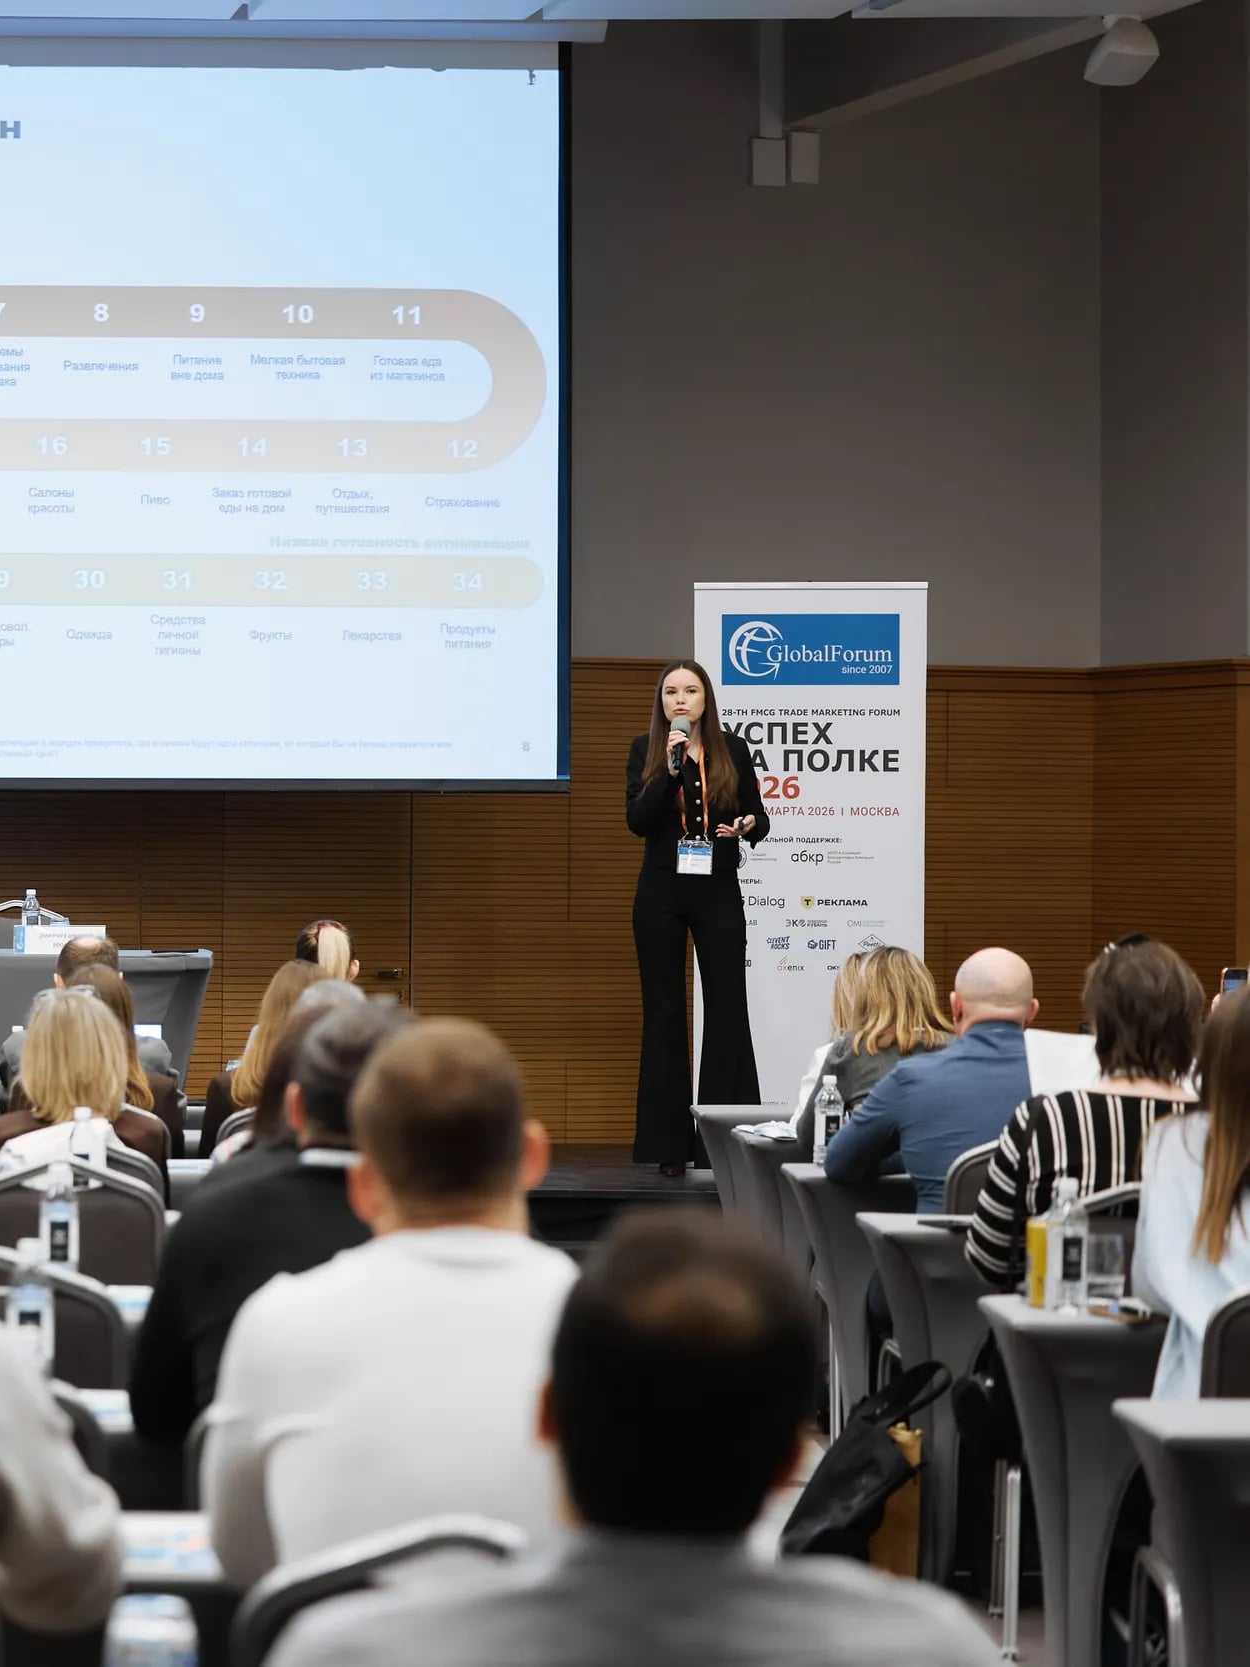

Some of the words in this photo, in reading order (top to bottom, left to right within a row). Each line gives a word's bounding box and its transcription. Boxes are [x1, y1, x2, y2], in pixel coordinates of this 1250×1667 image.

[94, 303, 108, 323] 8
[190, 303, 205, 323] 9
[282, 305, 314, 324] 10
[392, 306, 422, 324] 11
[63, 360, 138, 372] Развлечения
[172, 355, 222, 366] Питание
[250, 355, 292, 366] Мелкая
[296, 355, 346, 366] бытовая
[374, 356, 418, 367] Готовая
[419, 356, 442, 368] еда
[196, 370, 224, 382] дома
[276, 370, 320, 380] техника
[386, 371, 445, 382] магазинов
[38, 435, 68, 456] 16
[140, 436, 172, 456] 15
[236, 437, 268, 457] 14
[336, 438, 368, 458] 13
[448, 439, 478, 459] 12
[74, 570, 105, 589] 30
[163, 570, 192, 590] 31
[254, 570, 286, 590] 32
[358, 572, 388, 590] 33
[452, 572, 484, 591] 34
[766, 645, 892, 662] GlobalForum
[842, 665, 866, 673] since
[869, 665, 892, 674] 2007
[783, 750, 899, 772] ПОЛКЕ
[766, 807, 805, 816] МАРТА
[808, 807, 834, 816] 2026
[851, 807, 900, 817] МОСКВА
[791, 850, 823, 866] абкр
[748, 896, 785, 908] Dialog
[819, 940, 836, 950] GIFT
